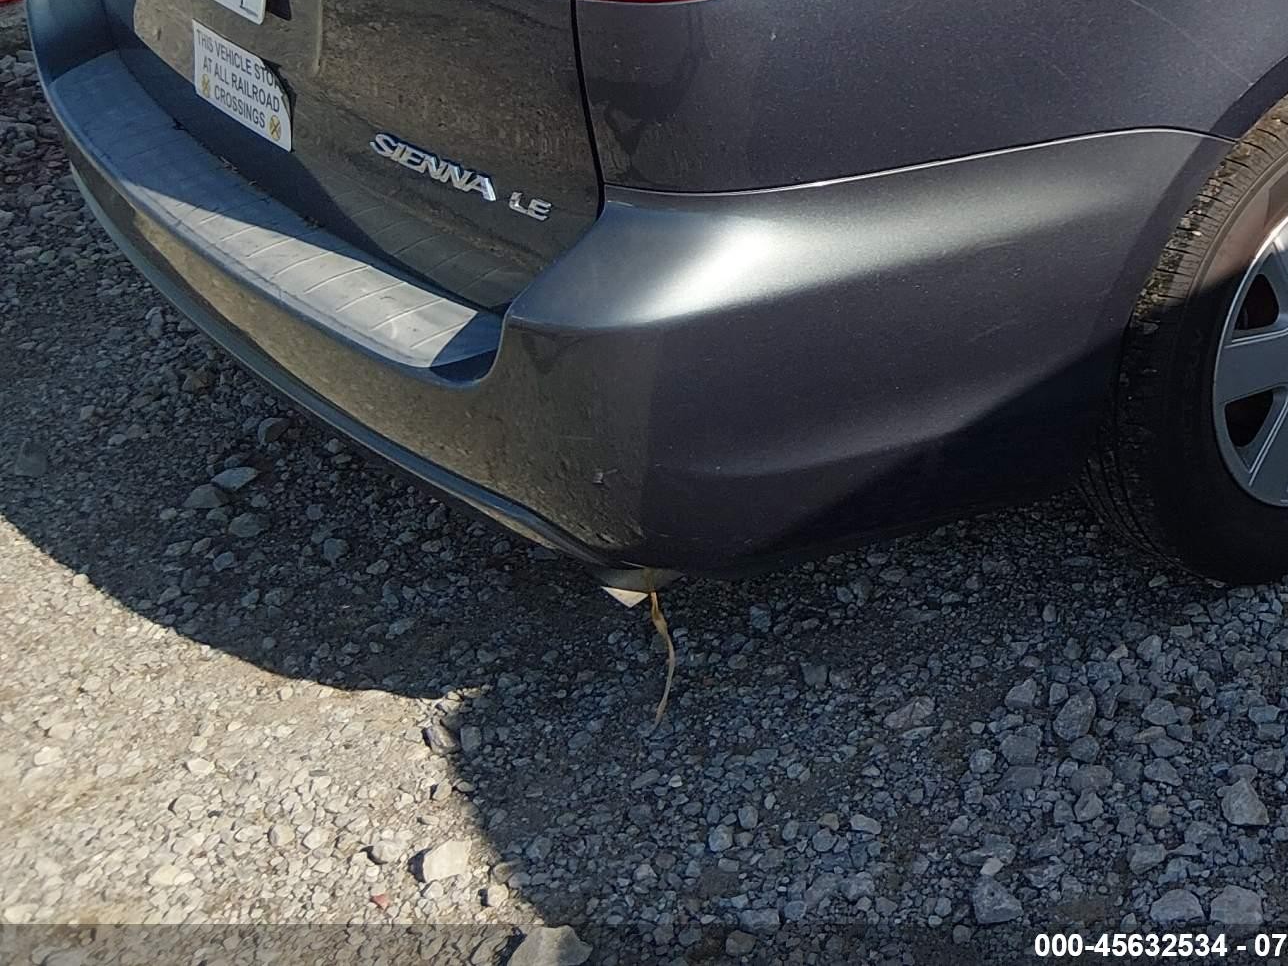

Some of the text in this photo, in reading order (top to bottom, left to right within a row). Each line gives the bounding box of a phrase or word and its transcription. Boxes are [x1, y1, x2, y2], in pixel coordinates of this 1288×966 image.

[196, 29, 214, 53] THIS
[215, 41, 252, 76] VEHICLE
[203, 56, 280, 113] AT ALL RAILROAD
[214, 85, 266, 129] CROSSINGS
[370, 133, 552, 221] SIENNA LE
